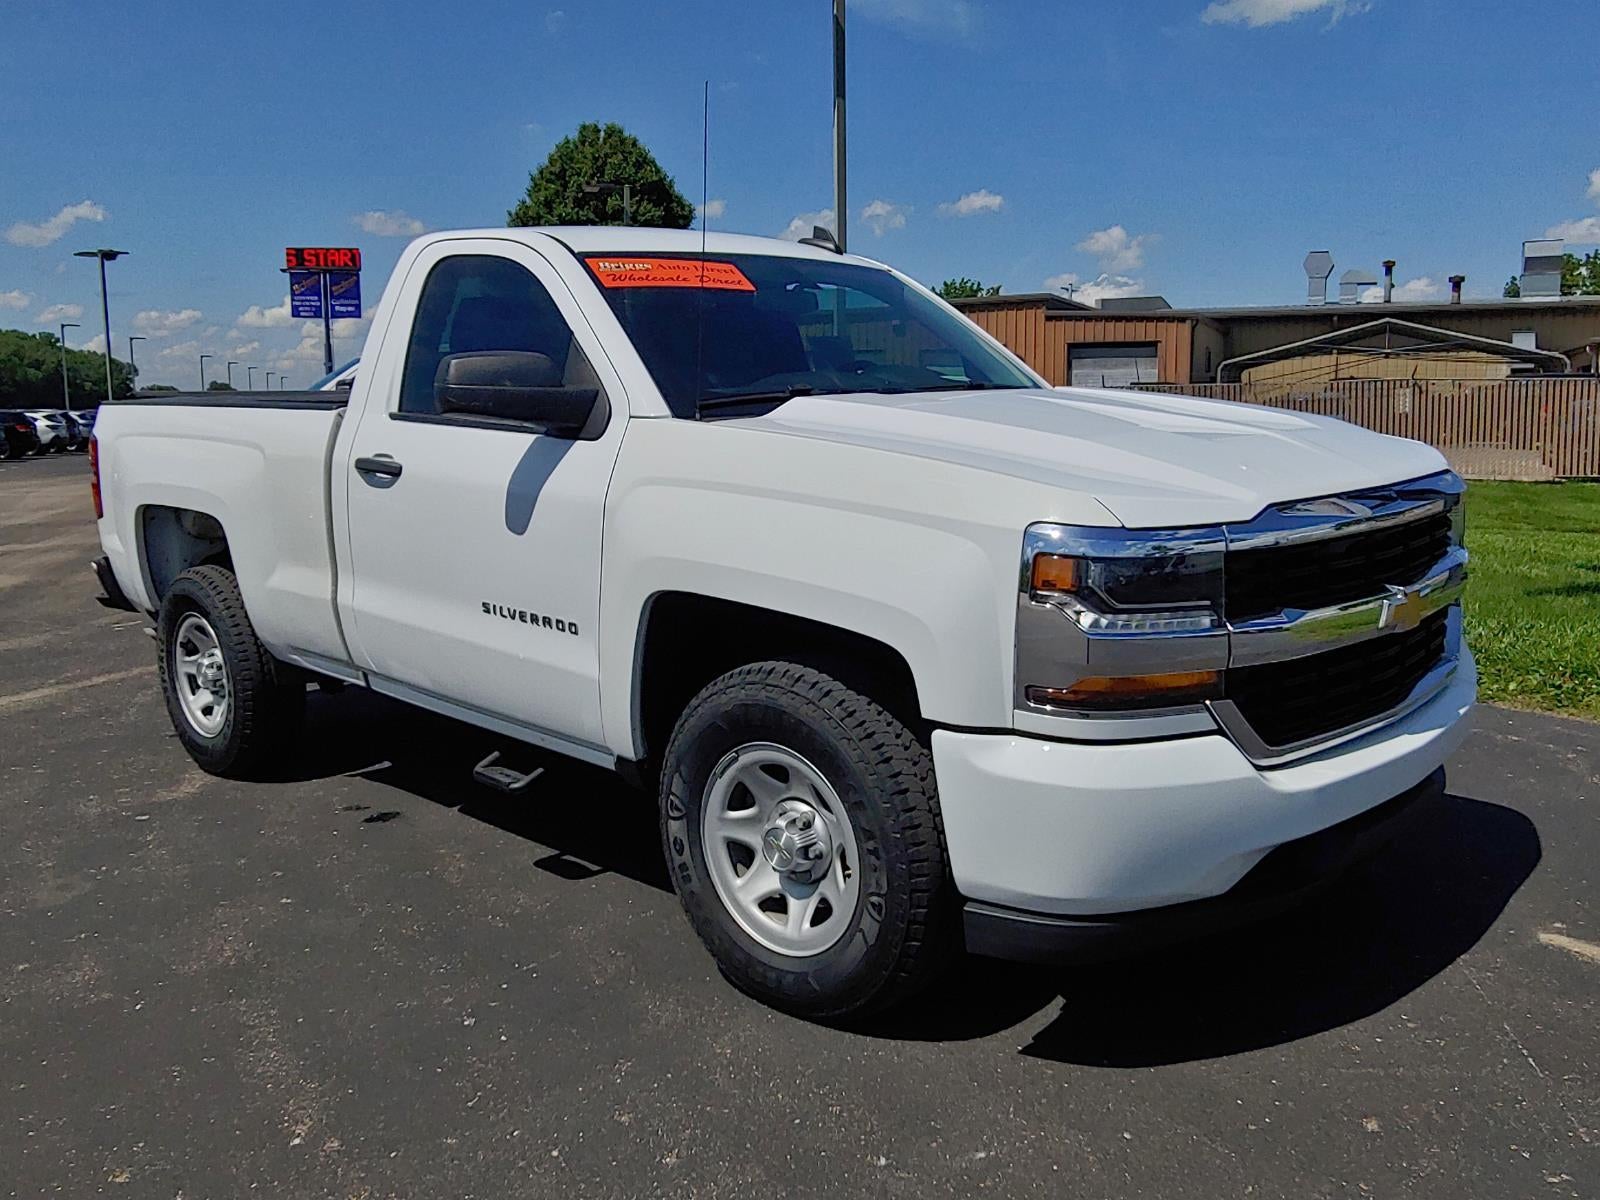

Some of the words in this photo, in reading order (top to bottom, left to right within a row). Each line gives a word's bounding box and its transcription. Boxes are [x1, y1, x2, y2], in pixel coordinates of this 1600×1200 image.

[303, 249, 360, 267] START
[655, 263, 690, 271] Auto
[606, 273, 690, 282] Wholesale
[694, 274, 744, 286] Direct
[482, 602, 579, 636] SILVERADO
